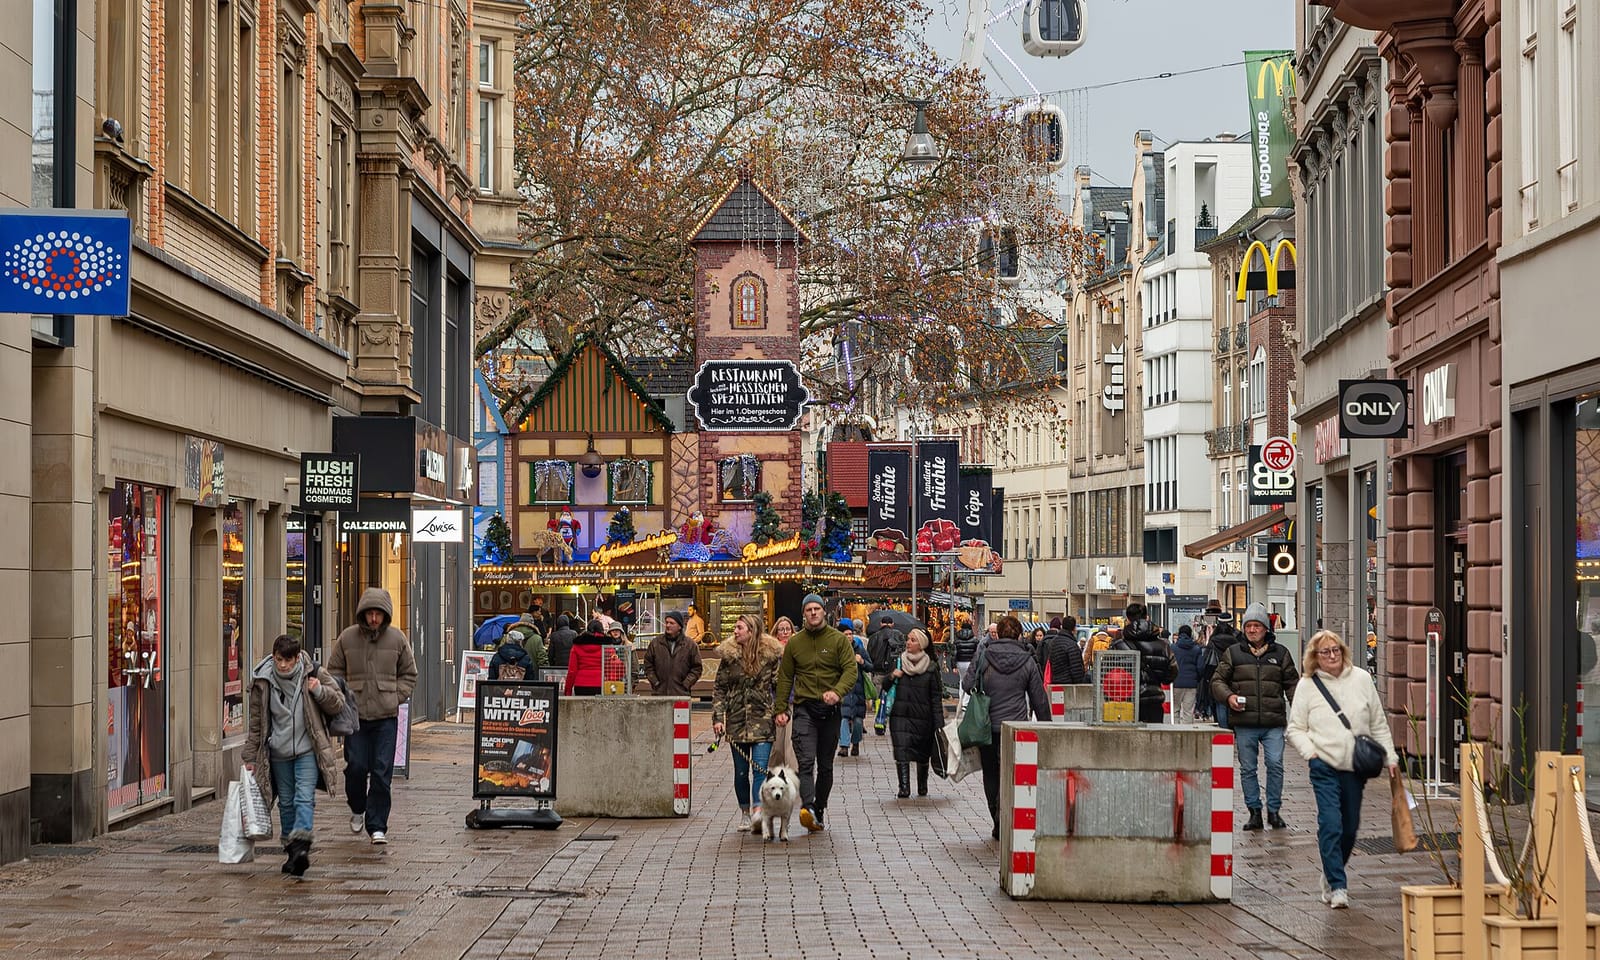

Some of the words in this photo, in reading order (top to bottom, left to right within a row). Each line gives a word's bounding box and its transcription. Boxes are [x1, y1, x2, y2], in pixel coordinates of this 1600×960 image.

[711, 368, 784, 383] RESTAURANT
[1103, 342, 1124, 417] fink
[729, 382, 788, 394] HESSISCHEN
[1423, 363, 1457, 426] ONLY
[711, 393, 784, 405] SPEZIALITÄTEN
[1346, 402, 1402, 416] ONLY
[306, 461, 354, 475] LUSH
[306, 475, 353, 488] FRESH
[923, 460, 931, 497] kandierte
[931, 456, 946, 511] Früchte
[305, 487, 353, 496] HANDMADE
[872, 474, 881, 502] Schoko
[880, 465, 896, 520] Früchte
[305, 495, 353, 504] COSMETICS
[965, 489, 984, 527] Crêpe
[343, 521, 407, 530] CALZEDONIA
[416, 516, 458, 536] Lovisa
[742, 531, 801, 562] Bratwurst
[484, 696, 527, 709] LEVEL
[529, 699, 550, 710] UP
[483, 708, 521, 721] WITH
